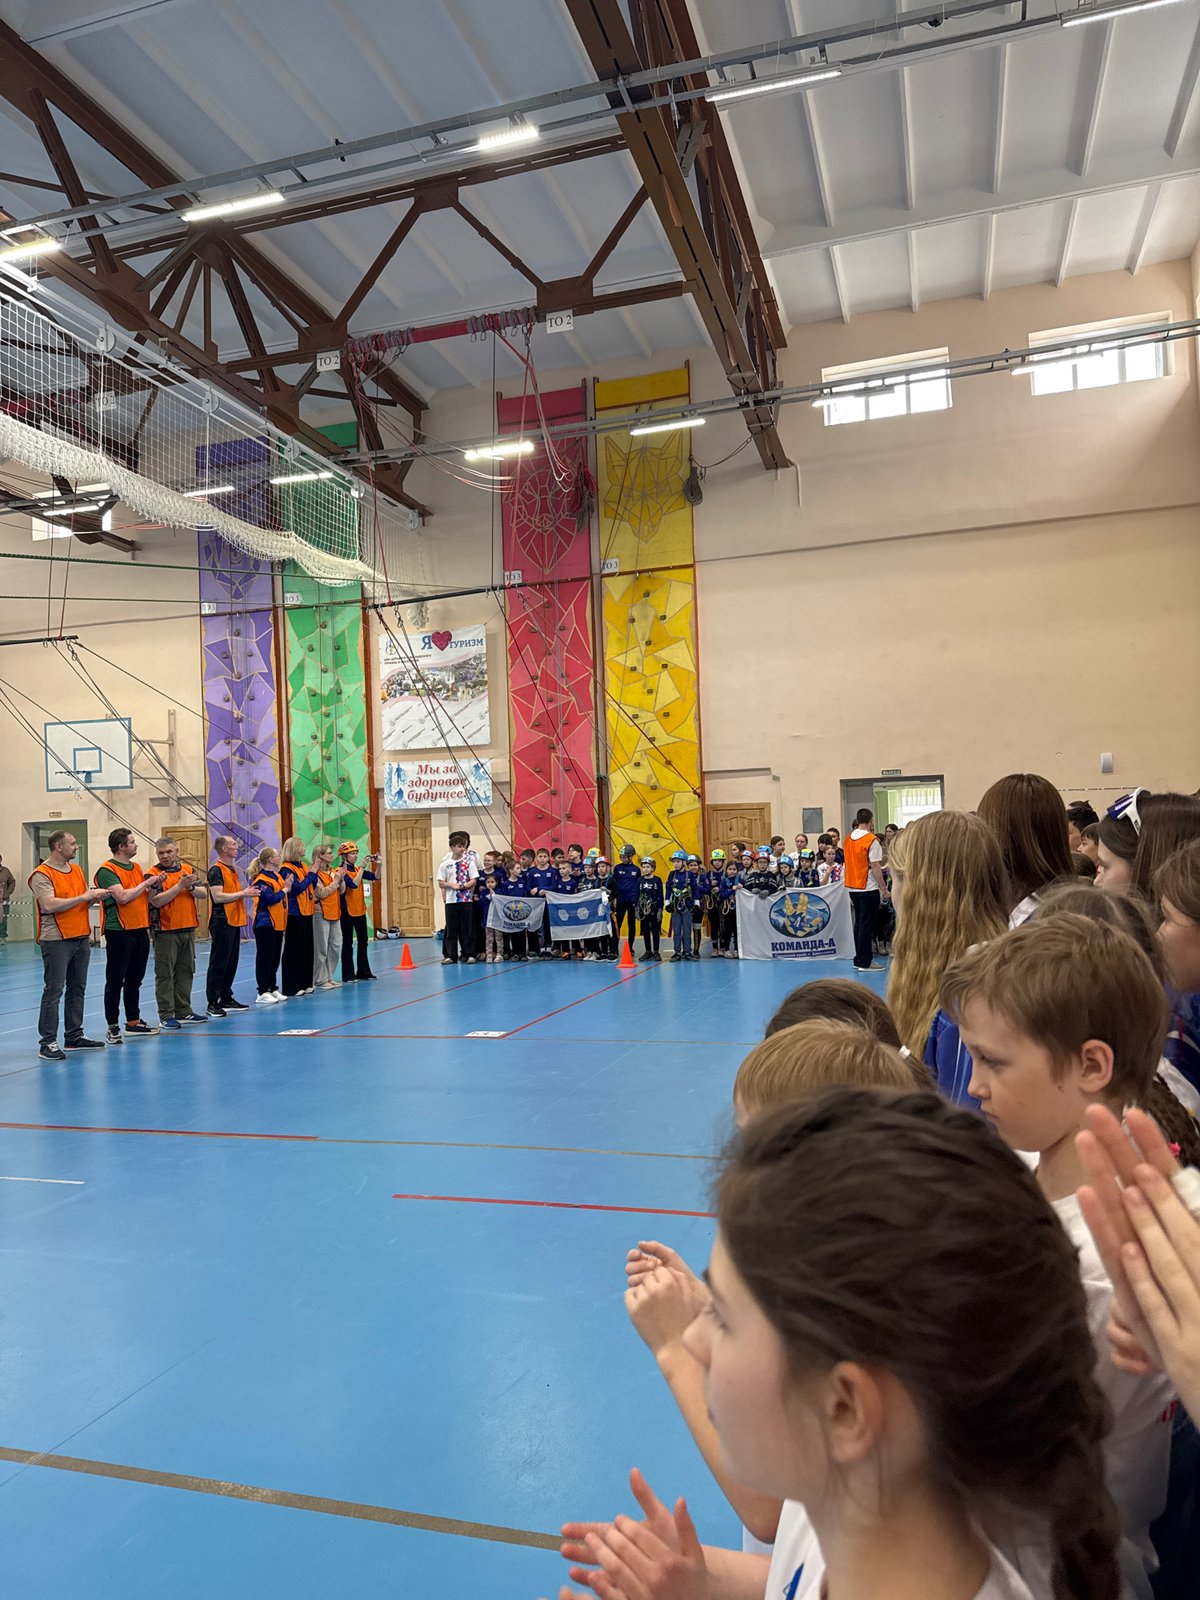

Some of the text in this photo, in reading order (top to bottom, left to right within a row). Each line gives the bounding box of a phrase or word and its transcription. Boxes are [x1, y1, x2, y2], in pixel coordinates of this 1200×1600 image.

[547, 314, 572, 328] ТО 2
[317, 355, 339, 367] ТО 2
[421, 635, 433, 650] Я
[449, 638, 484, 649] ТУРИЗМ
[417, 764, 457, 775] Мы за
[408, 777, 467, 789] здоровое
[771, 938, 836, 951] КОМАНДА-А
